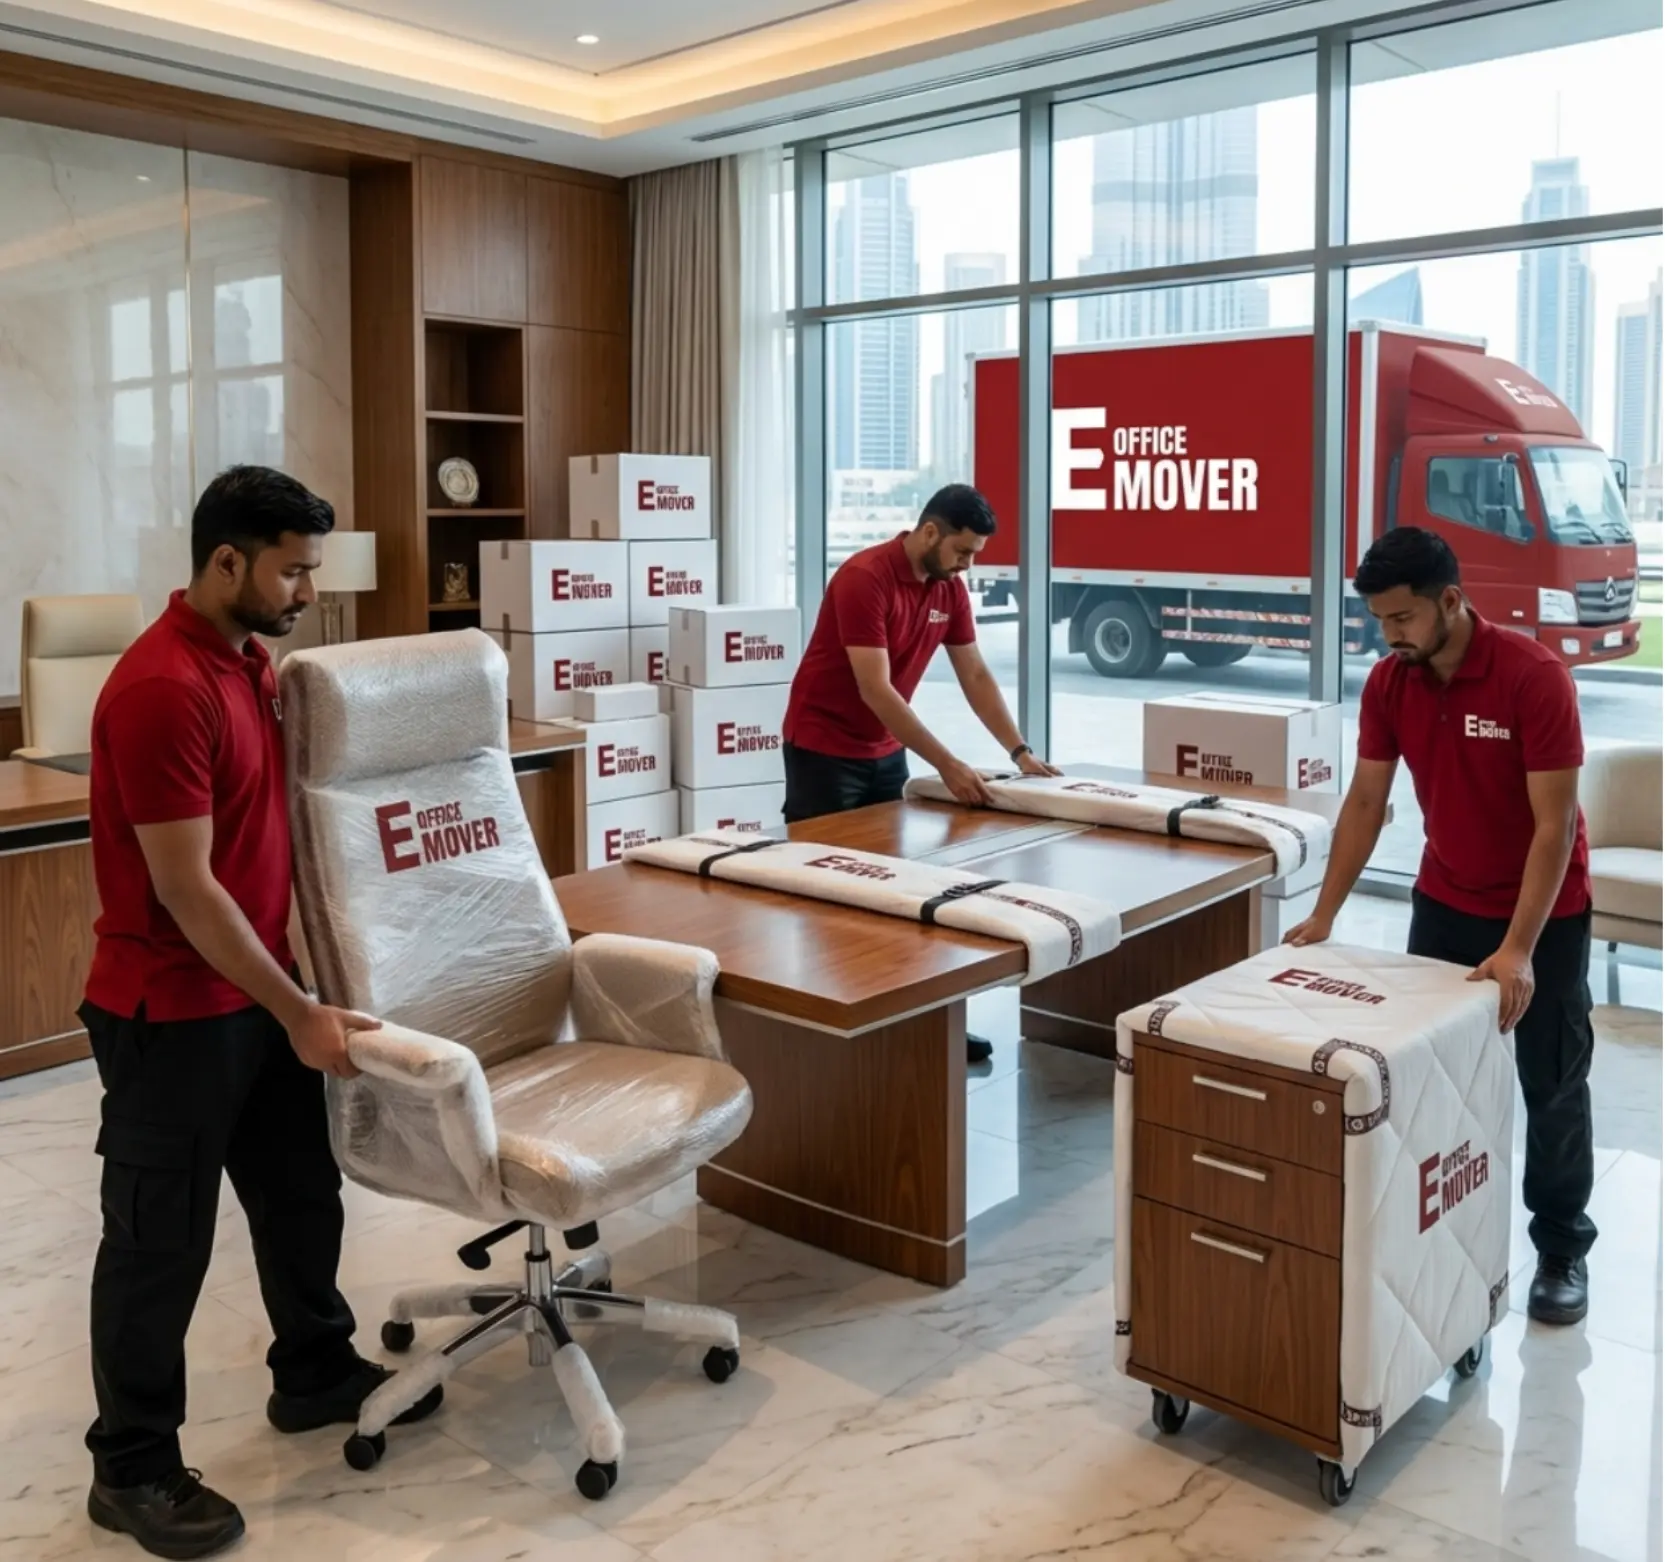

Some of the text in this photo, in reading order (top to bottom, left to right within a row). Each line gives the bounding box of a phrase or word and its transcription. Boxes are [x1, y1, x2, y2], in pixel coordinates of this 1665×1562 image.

[1113, 426, 1187, 455] OFFICE
[1052, 407, 1106, 510] E
[638, 480, 655, 510] E
[1113, 458, 1258, 511] MOVER
[551, 569, 570, 600] E
[648, 566, 664, 596] E
[726, 632, 742, 662] E
[554, 659, 571, 691] E
[648, 652, 663, 681] E
[718, 722, 735, 755] E
[1464, 714, 1478, 737] E
[598, 744, 616, 777] E
[375, 800, 422, 874] E
[421, 816, 500, 863] MOVER
[605, 828, 622, 862] E
[1267, 968, 1322, 987] E
[1419, 1152, 1441, 1235] E
